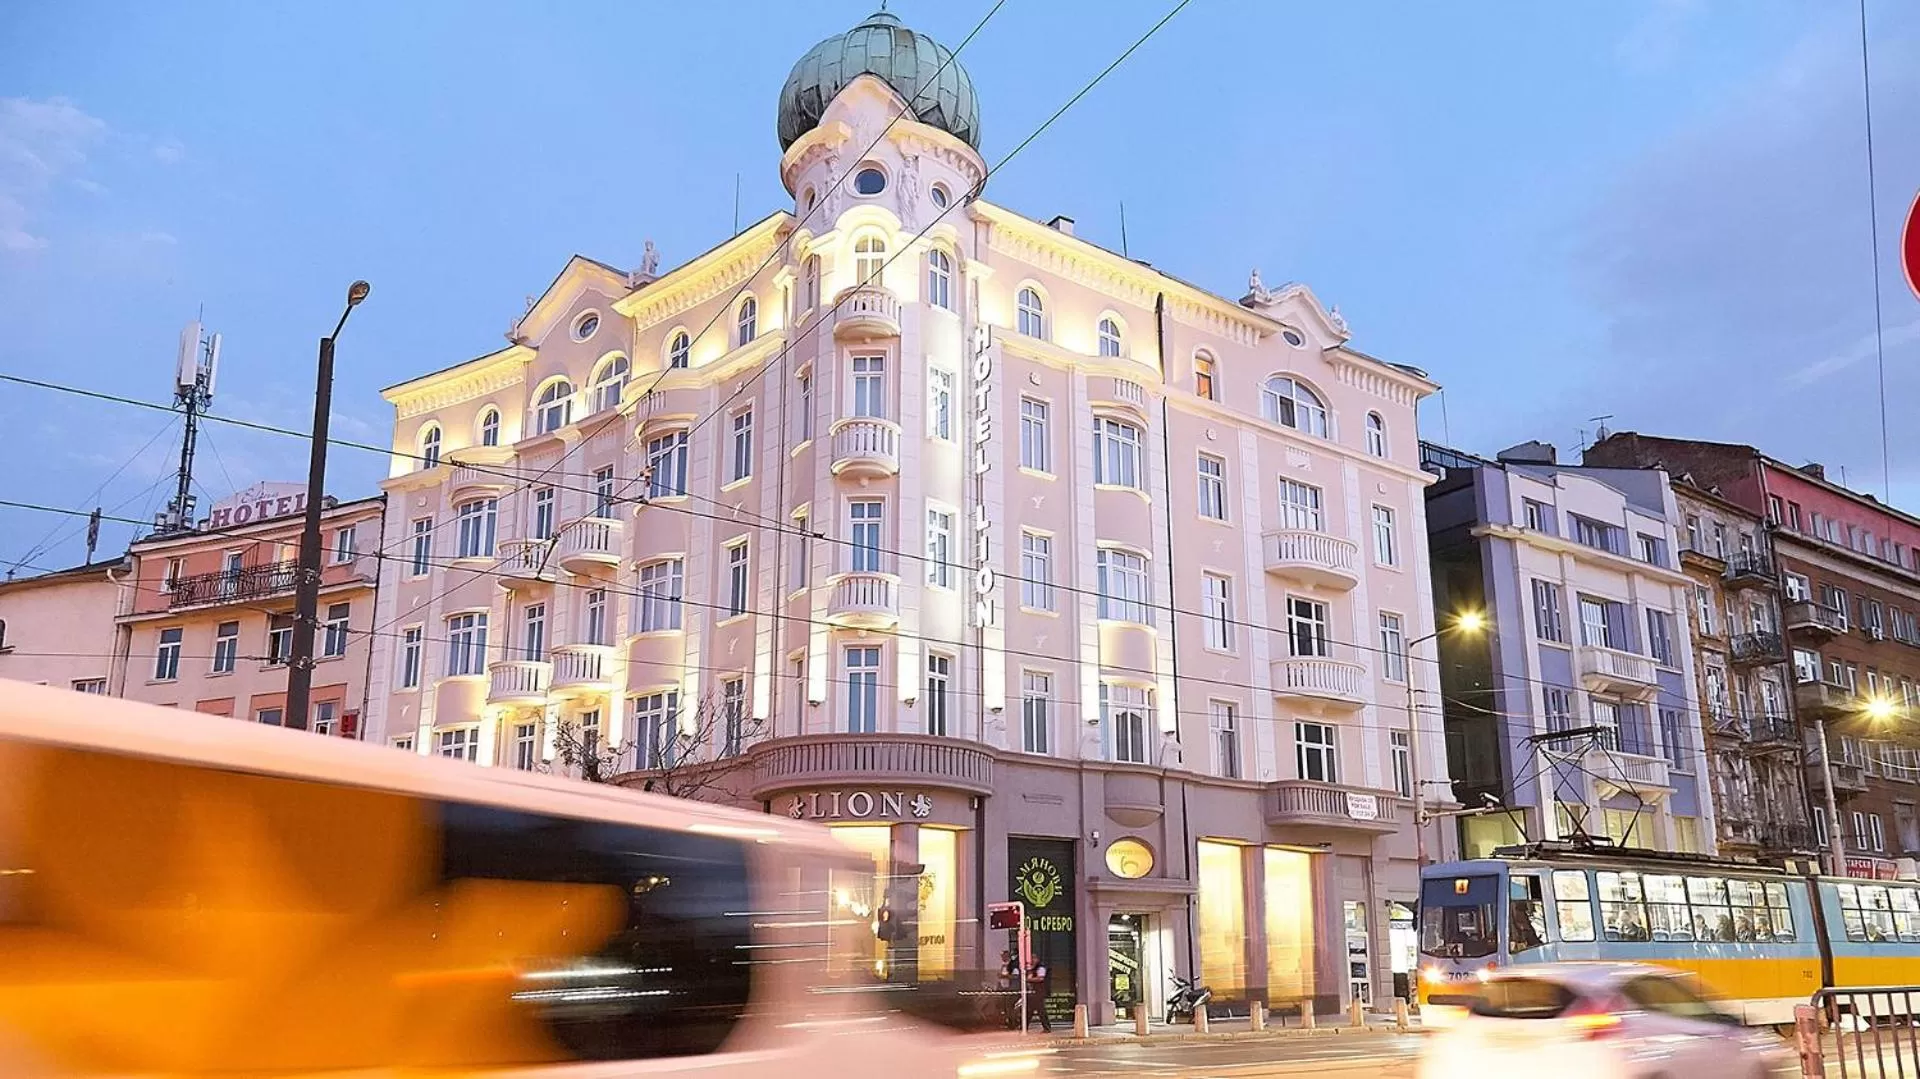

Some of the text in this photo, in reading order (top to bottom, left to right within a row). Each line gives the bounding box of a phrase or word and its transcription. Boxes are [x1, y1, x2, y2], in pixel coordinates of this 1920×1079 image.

[974, 323, 992, 475] HOTEL
[976, 503, 995, 627] LION
[809, 791, 904, 818] LION
[1041, 916, 1073, 931] СРЕБРО
